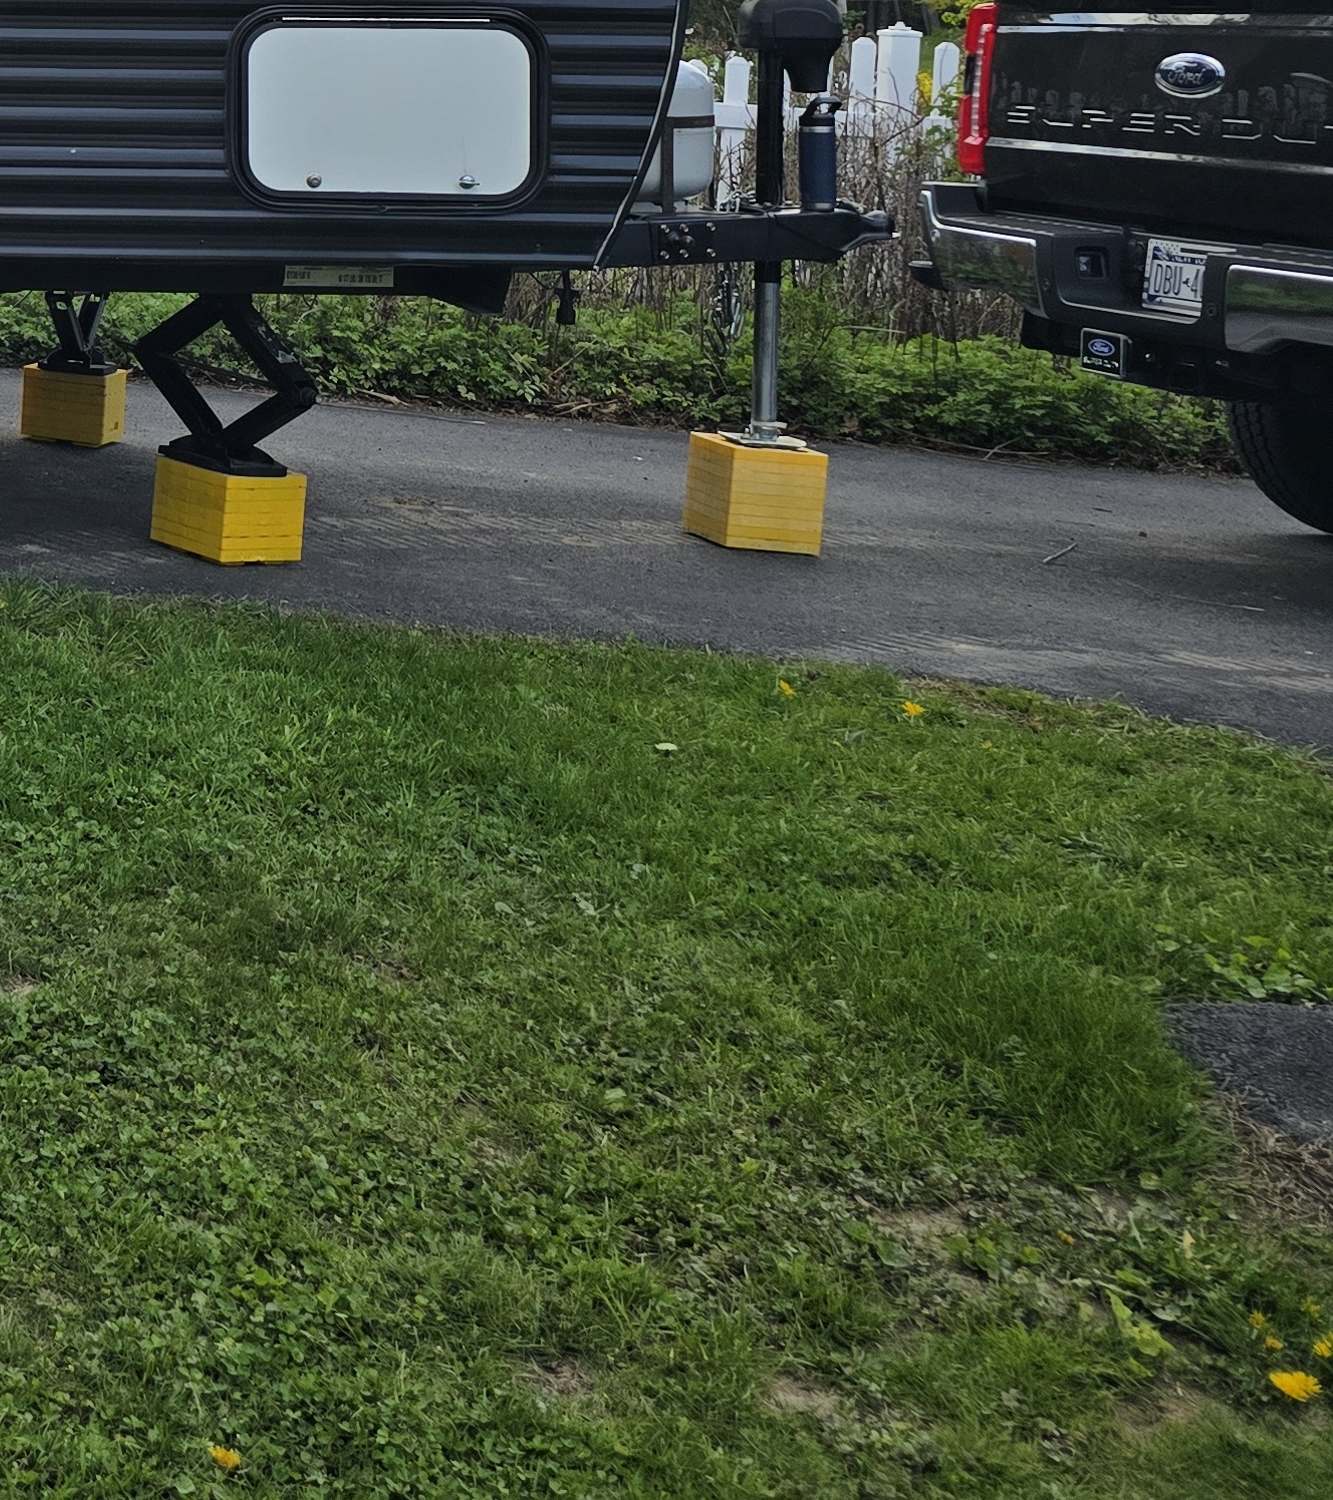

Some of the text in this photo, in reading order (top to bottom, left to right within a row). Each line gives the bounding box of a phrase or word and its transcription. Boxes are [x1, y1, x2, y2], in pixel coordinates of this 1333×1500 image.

[1167, 66, 1206, 86] Ford
[1007, 104, 1201, 136] SUPER
[1154, 264, 1183, 296] DBU
